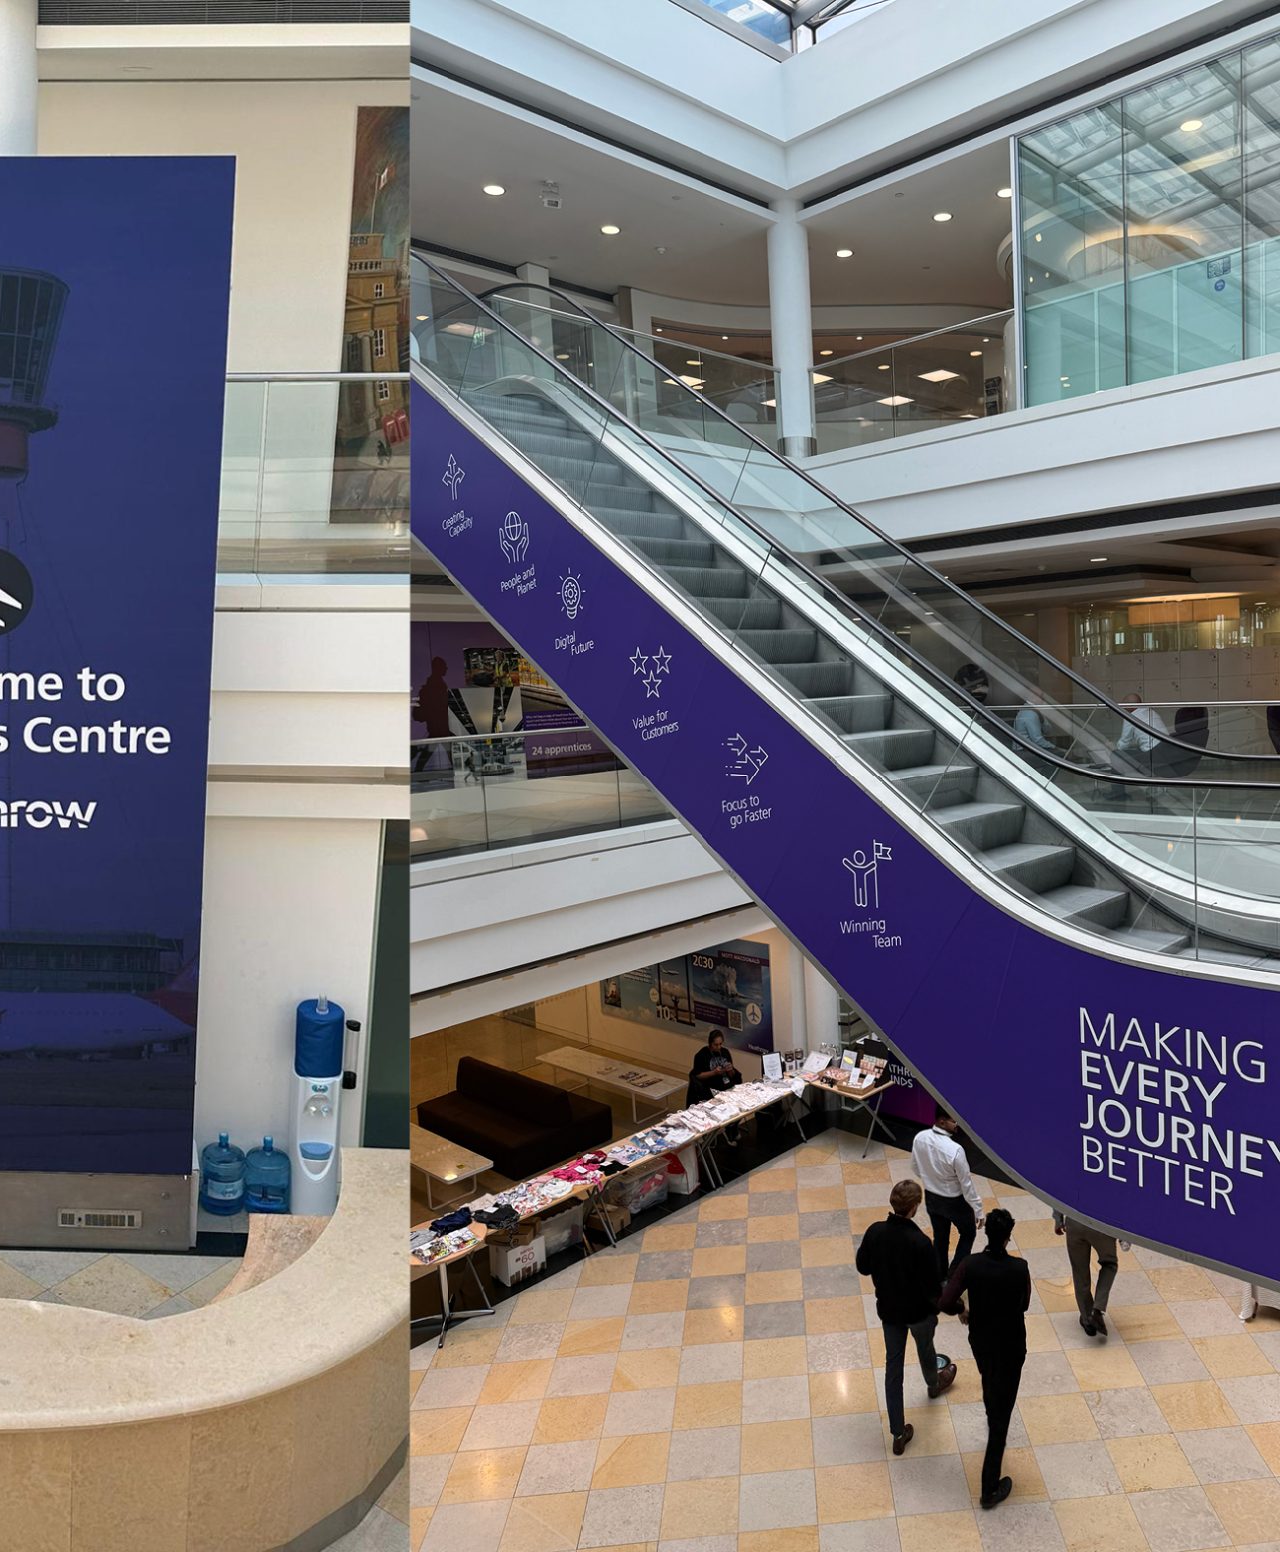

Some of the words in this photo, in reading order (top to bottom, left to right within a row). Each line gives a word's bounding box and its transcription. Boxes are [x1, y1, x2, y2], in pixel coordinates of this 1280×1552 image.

[442, 510, 465, 530] Creating
[449, 517, 473, 538] Capacity
[500, 573, 521, 592] People
[522, 563, 535, 580] and
[517, 578, 537, 597] Planet
[554, 630, 576, 650] Digital
[571, 640, 594, 656] Future
[77, 667, 126, 701] to
[632, 715, 655, 730] Value
[656, 709, 669, 722] for
[23, 716, 171, 754] Centre
[641, 721, 679, 741] Customers
[531, 746, 543, 756] 24
[545, 742, 592, 756] apprentices
[721, 798, 747, 814] Focus
[749, 795, 760, 807] to
[730, 813, 743, 829] go
[745, 807, 772, 824] Faster
[840, 918, 886, 934] Winning
[872, 934, 902, 948] Team
[692, 954, 714, 970] 2030
[1079, 1006, 1266, 1083] MAKING
[1081, 1050, 1227, 1118] EVERY
[1083, 1135, 1236, 1216] BETTER
